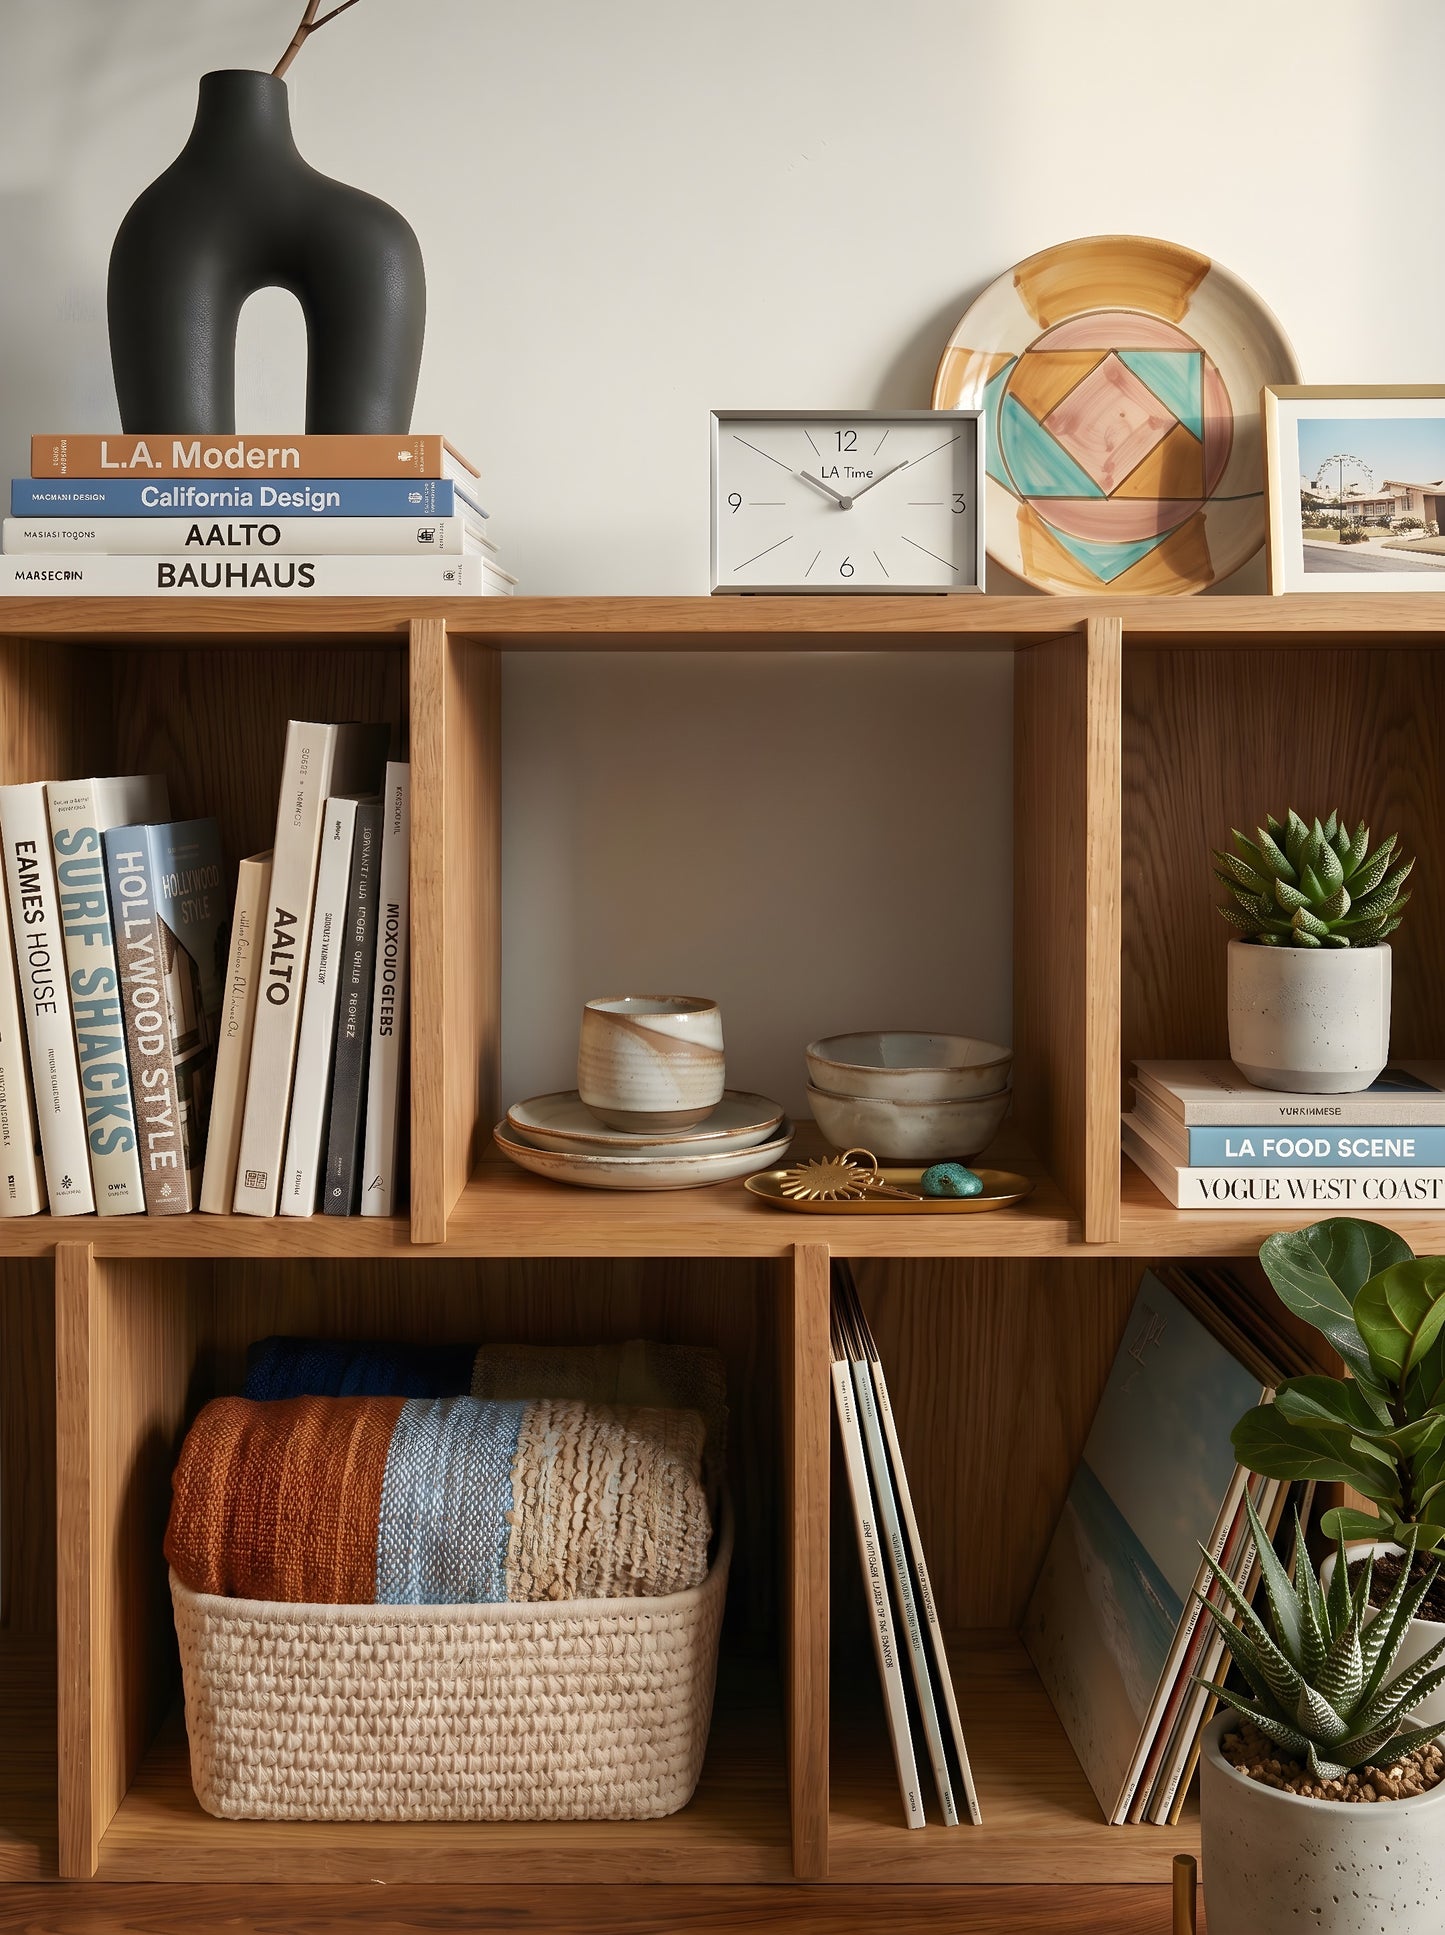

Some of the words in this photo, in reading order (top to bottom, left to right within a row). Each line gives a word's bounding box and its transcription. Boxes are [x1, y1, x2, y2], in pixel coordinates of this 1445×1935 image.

[834, 430, 858, 452] 12
[101, 441, 163, 469] L.A.
[172, 441, 301, 470] Modern
[821, 466, 840, 479] LA
[844, 466, 874, 479] Time
[141, 485, 253, 508] California
[259, 486, 341, 513] Design
[727, 492, 742, 514] 9
[951, 493, 966, 514] 3
[185, 524, 281, 547] AALTO
[157, 562, 316, 589] BAUHAUS
[839, 555, 855, 578] 6
[15, 840, 46, 925] EAMES
[54, 827, 111, 946] SURF
[162, 864, 220, 900] HOLLYWOOD
[181, 895, 210, 925] STYLE
[266, 907, 298, 1006] AALTO
[26, 933, 57, 1017] HOUSE
[116, 851, 164, 1057] HOLLYWOOD
[141, 1067, 178, 1171] STYLE
[71, 968, 136, 1156] SHACKS
[1225, 1139, 1256, 1158] LA
[1263, 1138, 1331, 1158] FOOD
[1337, 1138, 1416, 1158] SCENE
[108, 1183, 127, 1191] OWN
[1196, 1178, 1280, 1200] VOGUE
[1284, 1178, 1357, 1200] WEST
[1362, 1178, 1444, 1200] COAST
